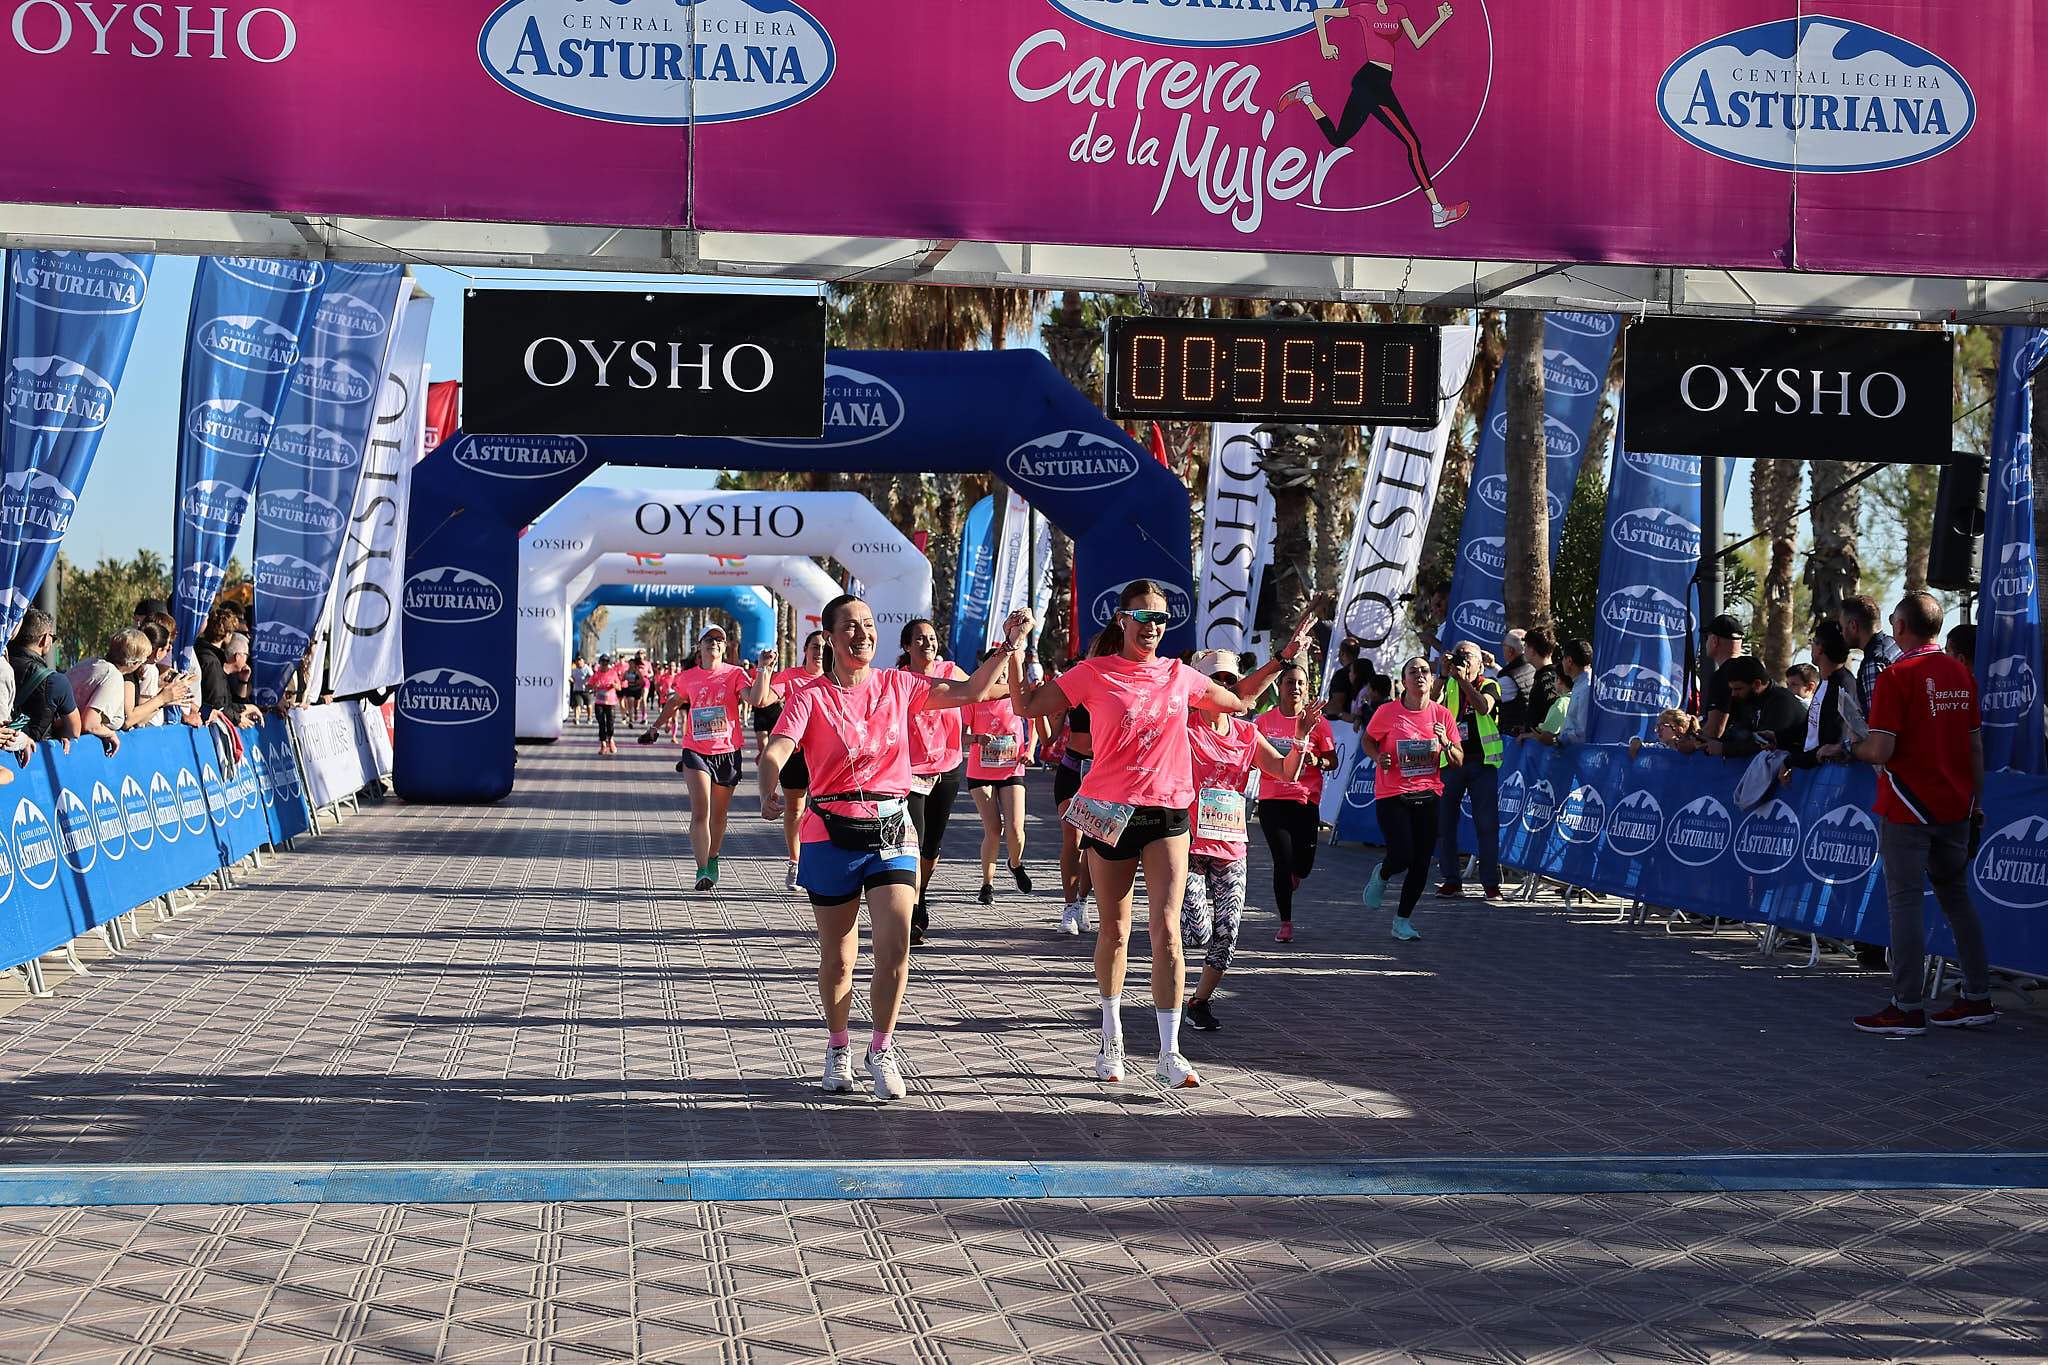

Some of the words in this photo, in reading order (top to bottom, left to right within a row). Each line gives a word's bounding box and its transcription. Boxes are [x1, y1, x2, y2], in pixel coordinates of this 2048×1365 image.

[12, 0, 297, 63] OYSHO
[562, 15, 673, 32] CENTRAL
[507, 16, 808, 84] ASTURIANA
[1008, 29, 1261, 114] Carrera
[1732, 68, 1830, 85] CENTRAL
[1841, 71, 1941, 88] LECHERA
[1682, 69, 1950, 135] ASTURIANA
[1069, 112, 1115, 165] de
[1127, 112, 1159, 167] la
[1151, 109, 1353, 233] Mujer
[13, 254, 137, 305] ASTURIANA
[32, 256, 83, 273] CENTRAL
[88, 266, 136, 282] LECHERA
[523, 336, 774, 393] OYSHO
[1132, 336, 1414, 405] 00:36:31
[294, 373, 364, 398] STURIANA
[825, 387, 881, 398] ECHERA
[1680, 364, 1906, 418] OYSHO
[8, 387, 106, 422] STURIANA
[193, 412, 270, 447] ASTURIAN
[269, 432, 350, 464] ASTURIANA
[461, 438, 577, 465] ASTURIANA
[1017, 454, 1131, 476] ASTURIANA
[258, 498, 337, 529] ASTURIANA
[635, 502, 804, 538] OYSHO
[533, 539, 584, 550] OYSHO
[852, 543, 901, 554] OYSHO
[1344, 428, 1436, 648] OYSH
[1618, 520, 1701, 556] ASTURIANA
[255, 570, 324, 594] STURIANA
[404, 586, 496, 611] ASTURIANA
[517, 606, 556, 619] YSHO
[1607, 600, 1686, 633] ASTURIANA
[515, 676, 554, 688] YSHO
[401, 687, 492, 712] ASTURIANA
[1609, 811, 1656, 841] ASTURIANA
[1668, 818, 1725, 850] ASTURIANA
[1737, 824, 1794, 857] ASTURIANA
[1806, 830, 1872, 867] ASTURIANA
[1979, 847, 2048, 887] ASTURIA
